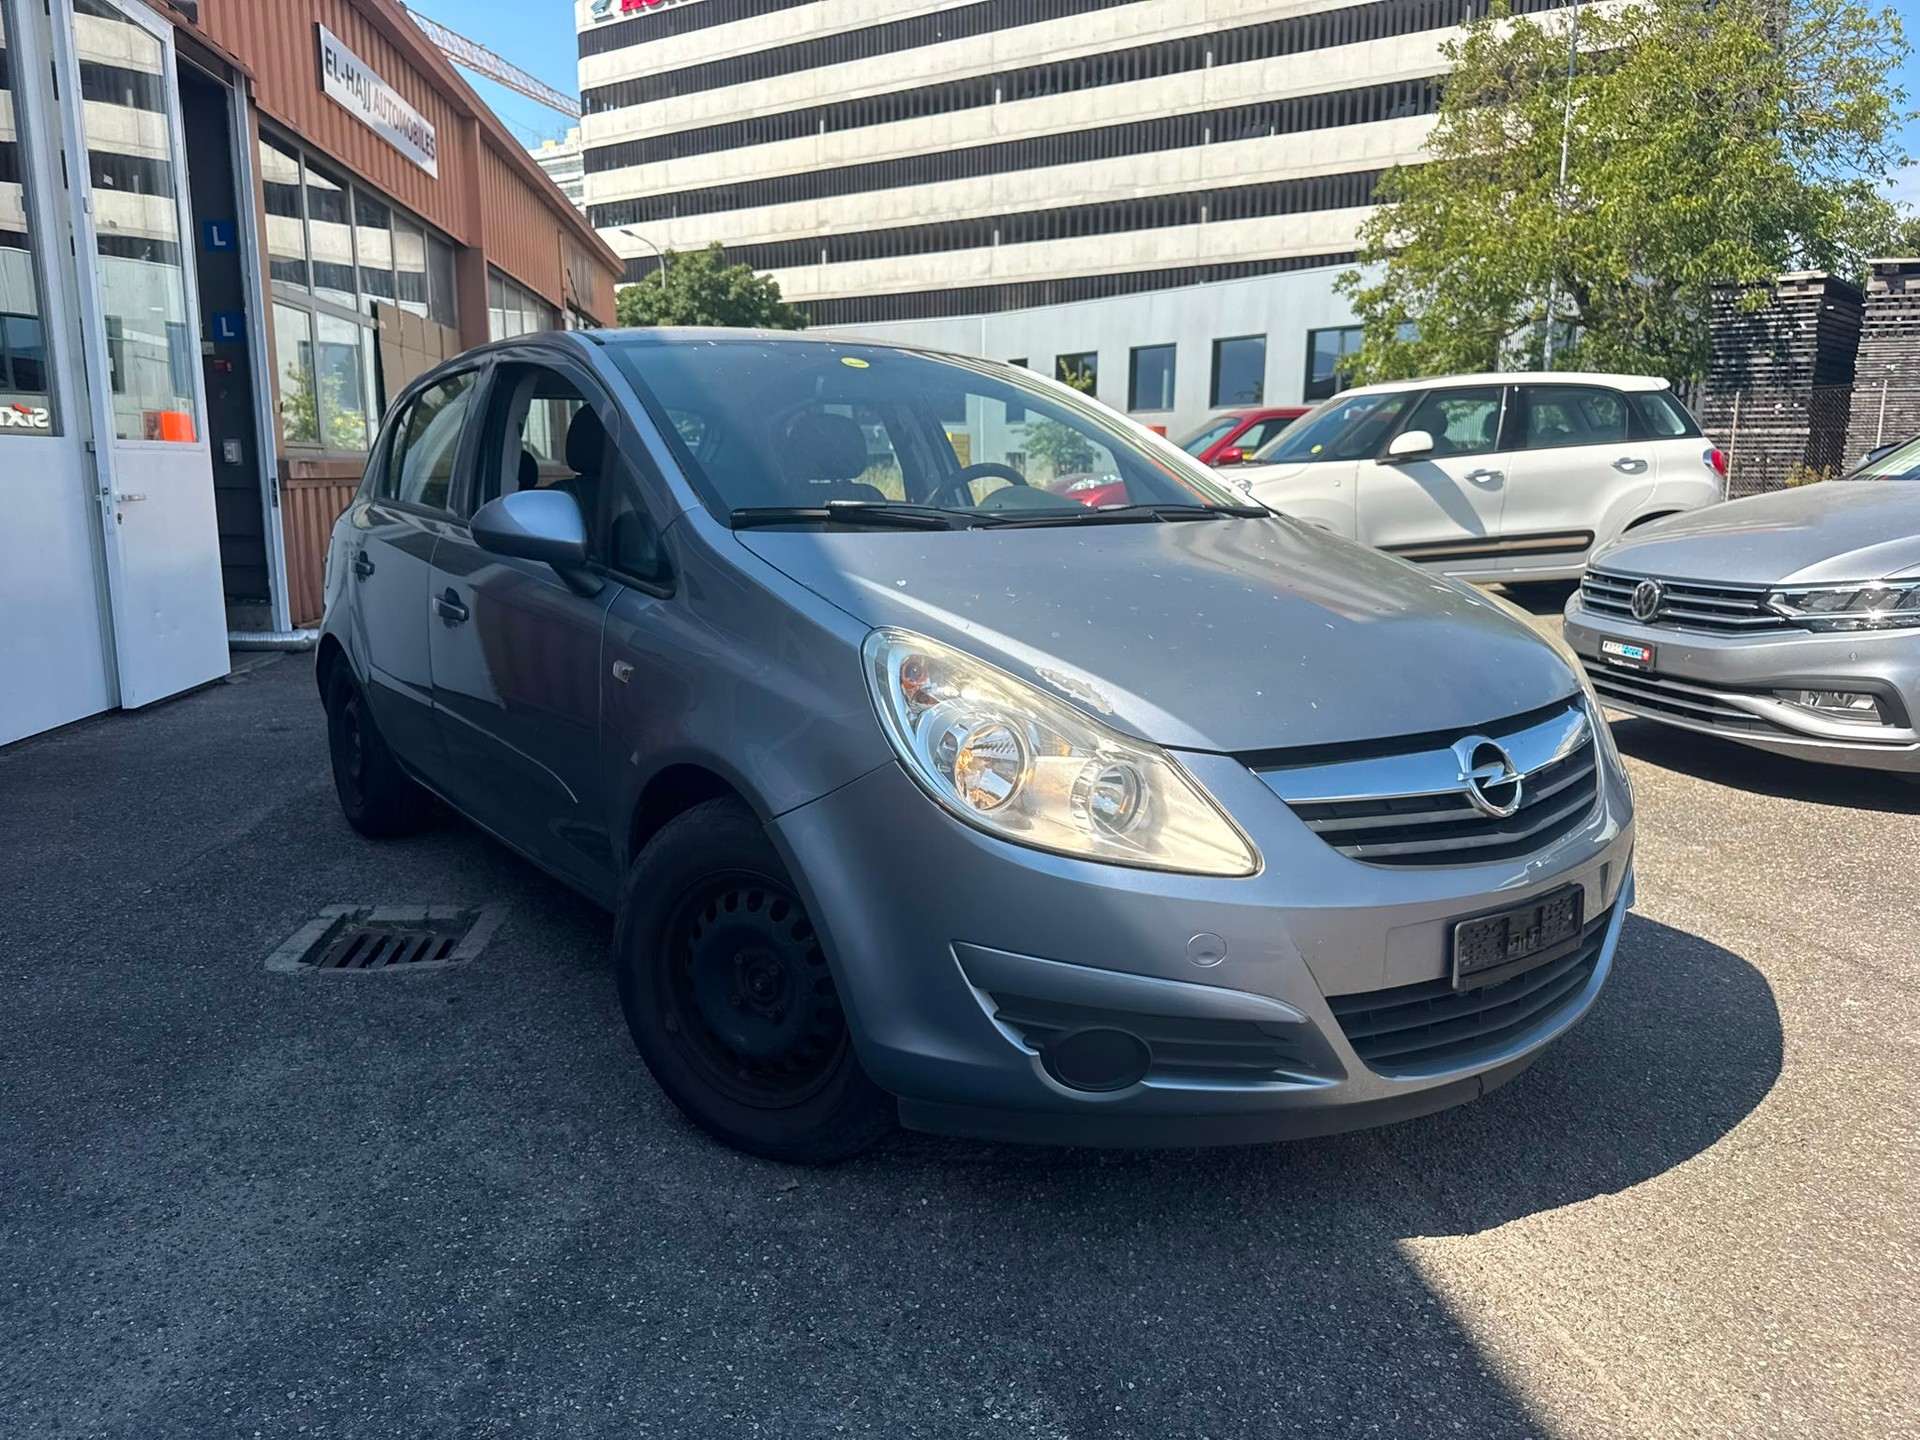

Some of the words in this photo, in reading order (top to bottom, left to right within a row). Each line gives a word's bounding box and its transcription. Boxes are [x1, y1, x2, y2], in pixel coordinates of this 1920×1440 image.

[324, 45, 371, 113] EL-HAJJ
[373, 87, 436, 160] AUTOMOBILES
[212, 225, 226, 246] L
[221, 317, 235, 337] L
